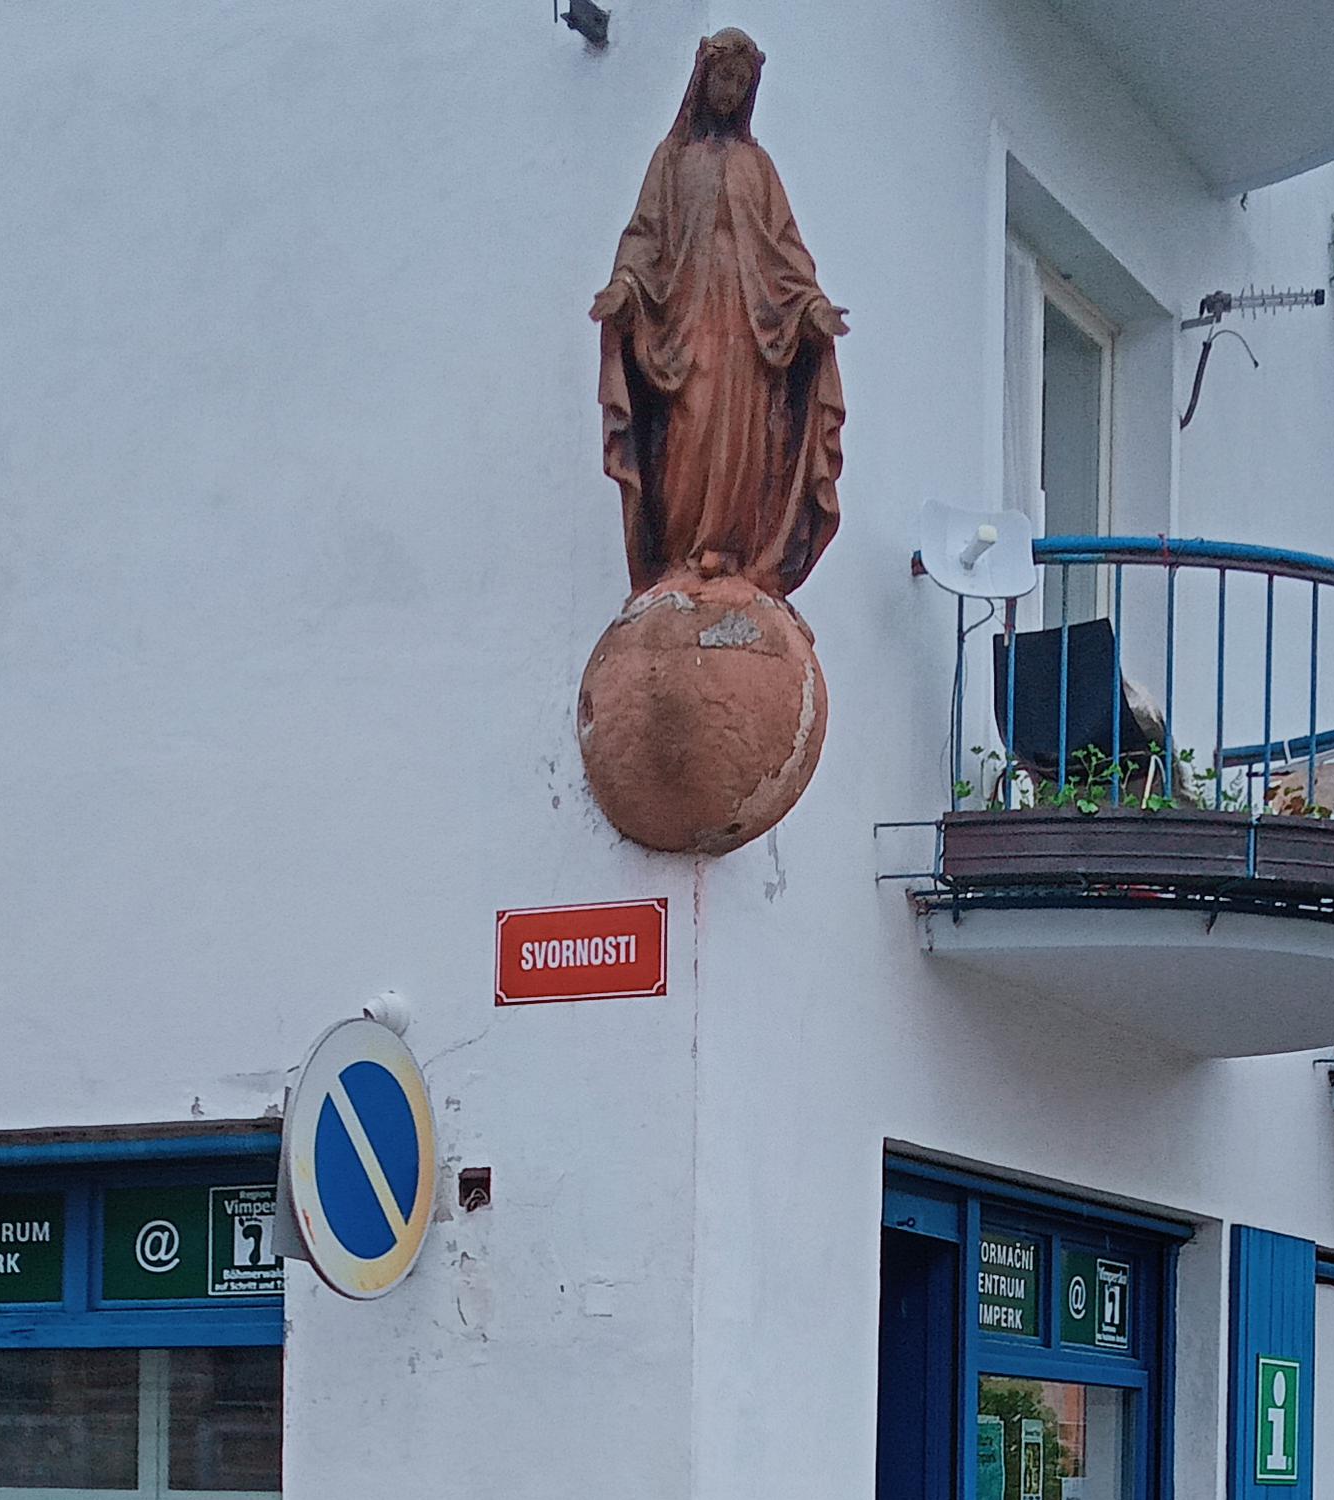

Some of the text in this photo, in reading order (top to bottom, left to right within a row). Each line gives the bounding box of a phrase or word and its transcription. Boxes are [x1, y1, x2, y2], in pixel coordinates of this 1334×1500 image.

[521, 935, 636, 970] SVORNOSTI
[224, 1199, 276, 1216] Vimper
[135, 1220, 180, 1272] @
[979, 1241, 1035, 1271] ORMAČNÍ
[978, 1272, 1025, 1299] ENTRUM
[979, 1303, 1022, 1329] IMPERK
